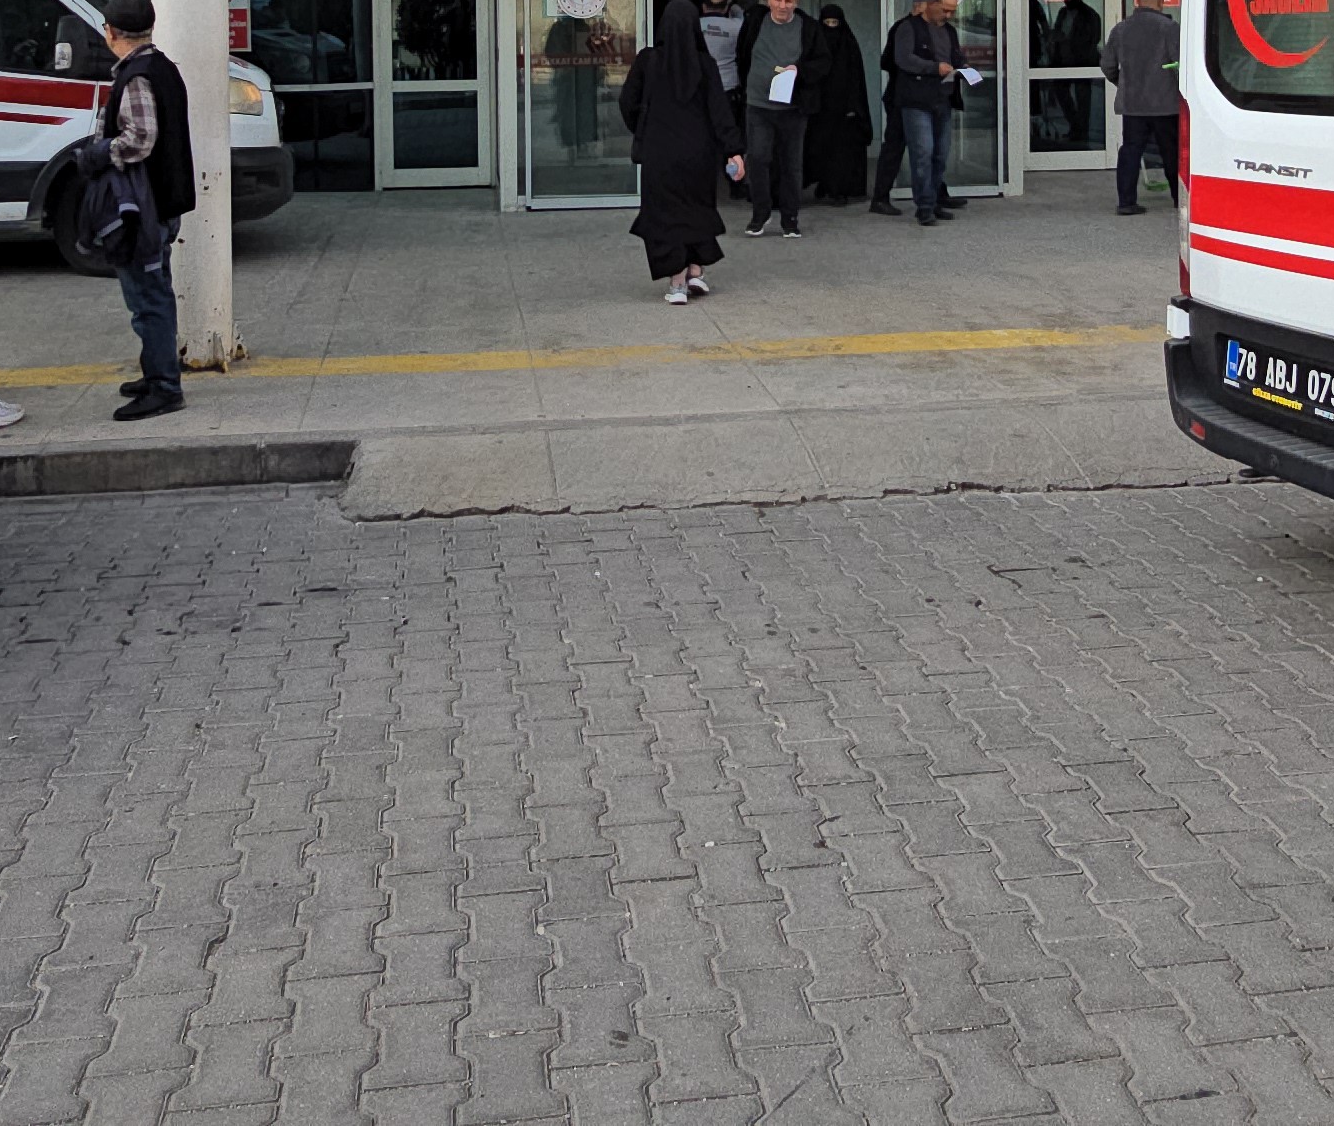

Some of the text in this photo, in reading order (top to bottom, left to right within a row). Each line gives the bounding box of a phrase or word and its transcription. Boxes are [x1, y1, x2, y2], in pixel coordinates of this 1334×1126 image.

[1233, 158, 1314, 179] TRANSIT
[1237, 347, 1257, 381] 78
[1264, 357, 1299, 394] ABJ
